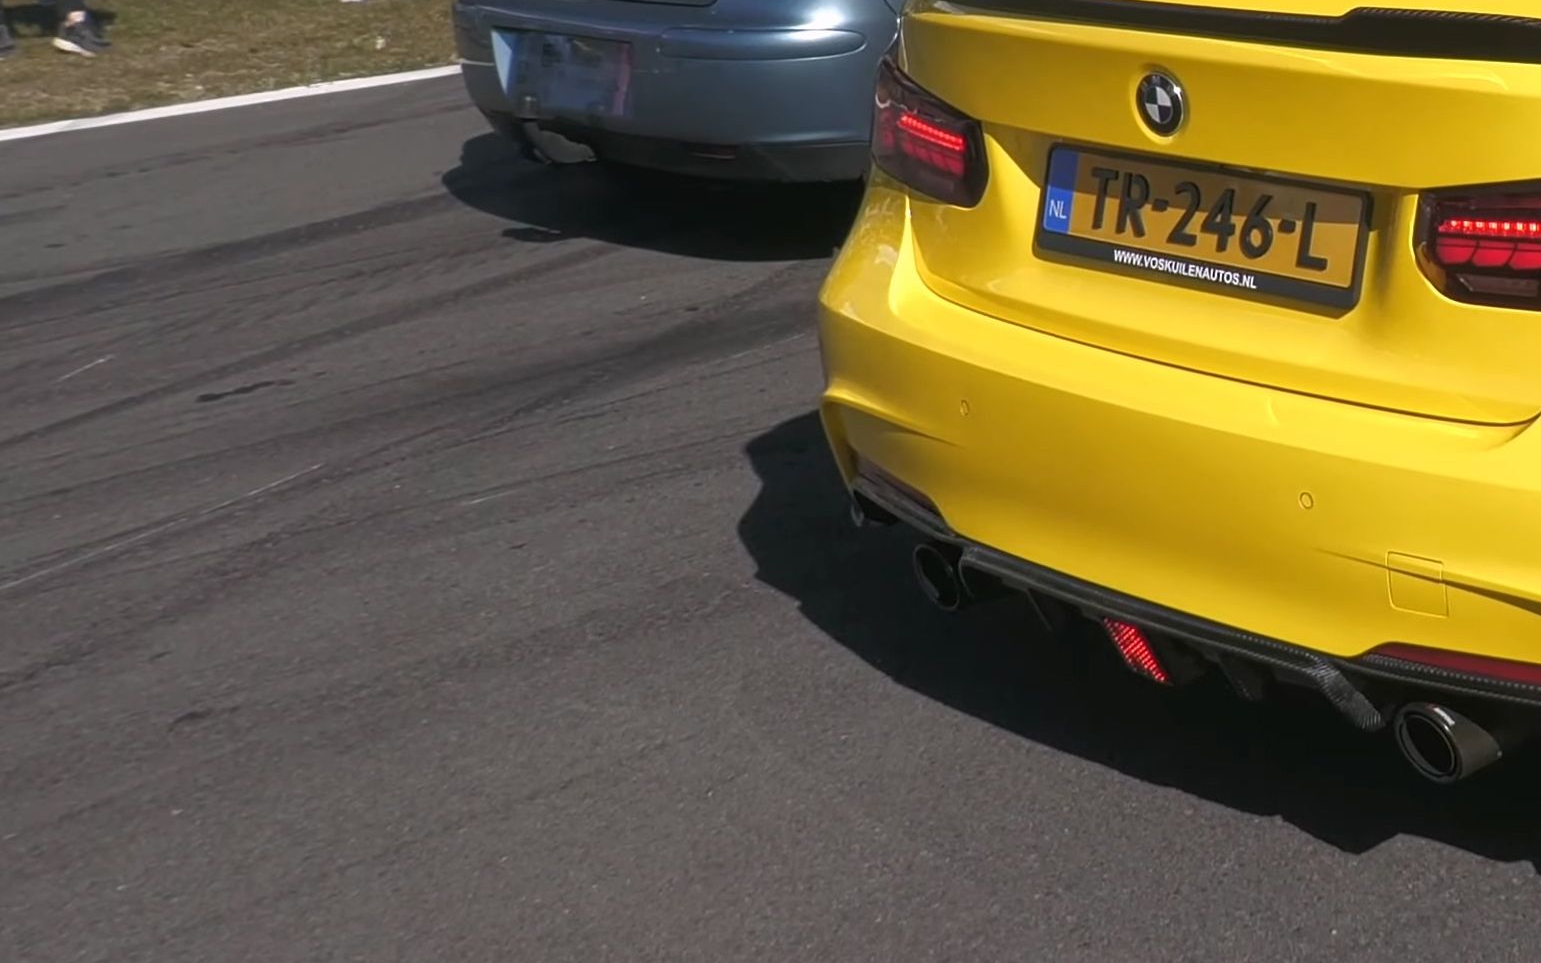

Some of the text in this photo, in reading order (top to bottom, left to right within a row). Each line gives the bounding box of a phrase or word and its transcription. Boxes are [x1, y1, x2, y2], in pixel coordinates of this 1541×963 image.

[1049, 199, 1067, 219] NL
[1090, 166, 1329, 272] TR-246-L
[1113, 249, 1258, 289] WWW.VOSKUILENAUTOS.NL
